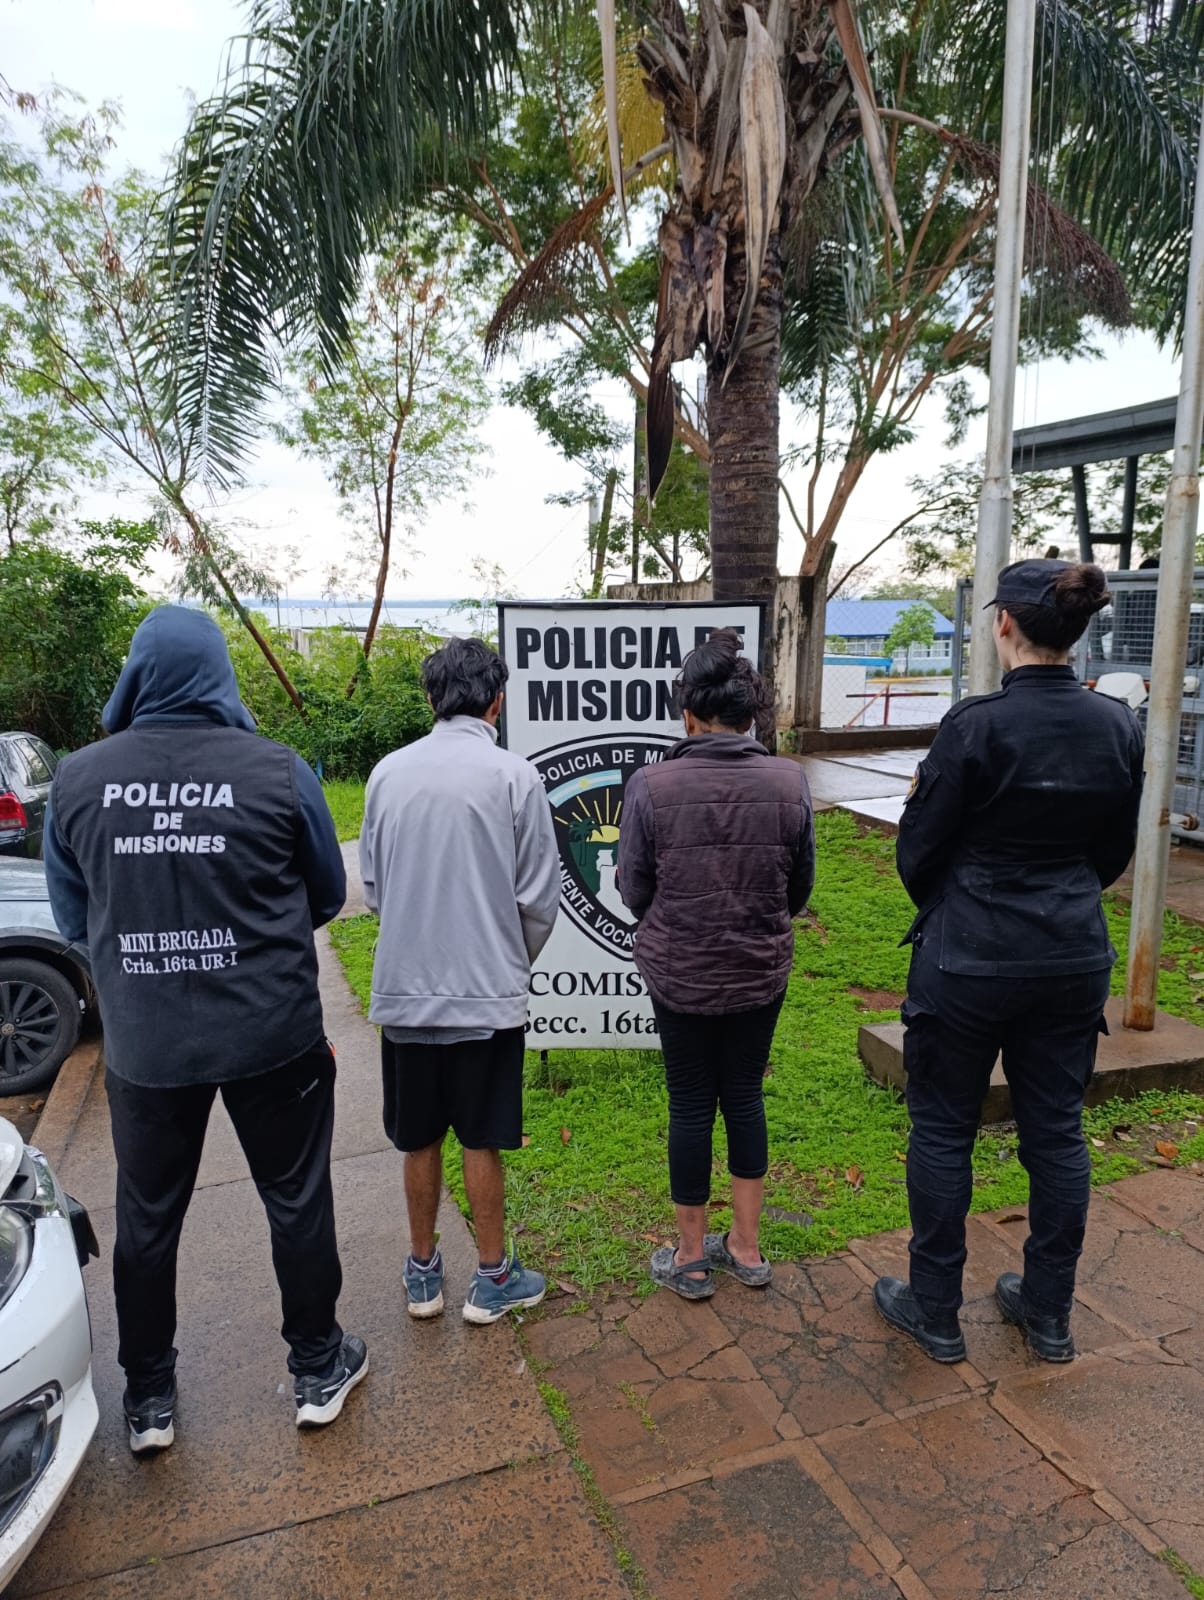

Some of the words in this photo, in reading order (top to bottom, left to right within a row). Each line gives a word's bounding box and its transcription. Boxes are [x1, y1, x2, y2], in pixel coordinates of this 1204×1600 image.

[516, 626, 682, 670] POLICIA
[528, 679, 684, 722] MISION
[612, 749, 635, 764] DE
[102, 783, 235, 807] POLICIA
[153, 812, 184, 830] DE
[114, 835, 226, 854] MISIONES
[118, 933, 156, 953] MINI
[157, 928, 237, 952] BRIGADA
[122, 957, 159, 974] Cria.
[162, 955, 197, 973] 16ta
[200, 951, 238, 971] UR-I
[529, 971, 650, 997] COMIS
[600, 1009, 660, 1034] 16ta
